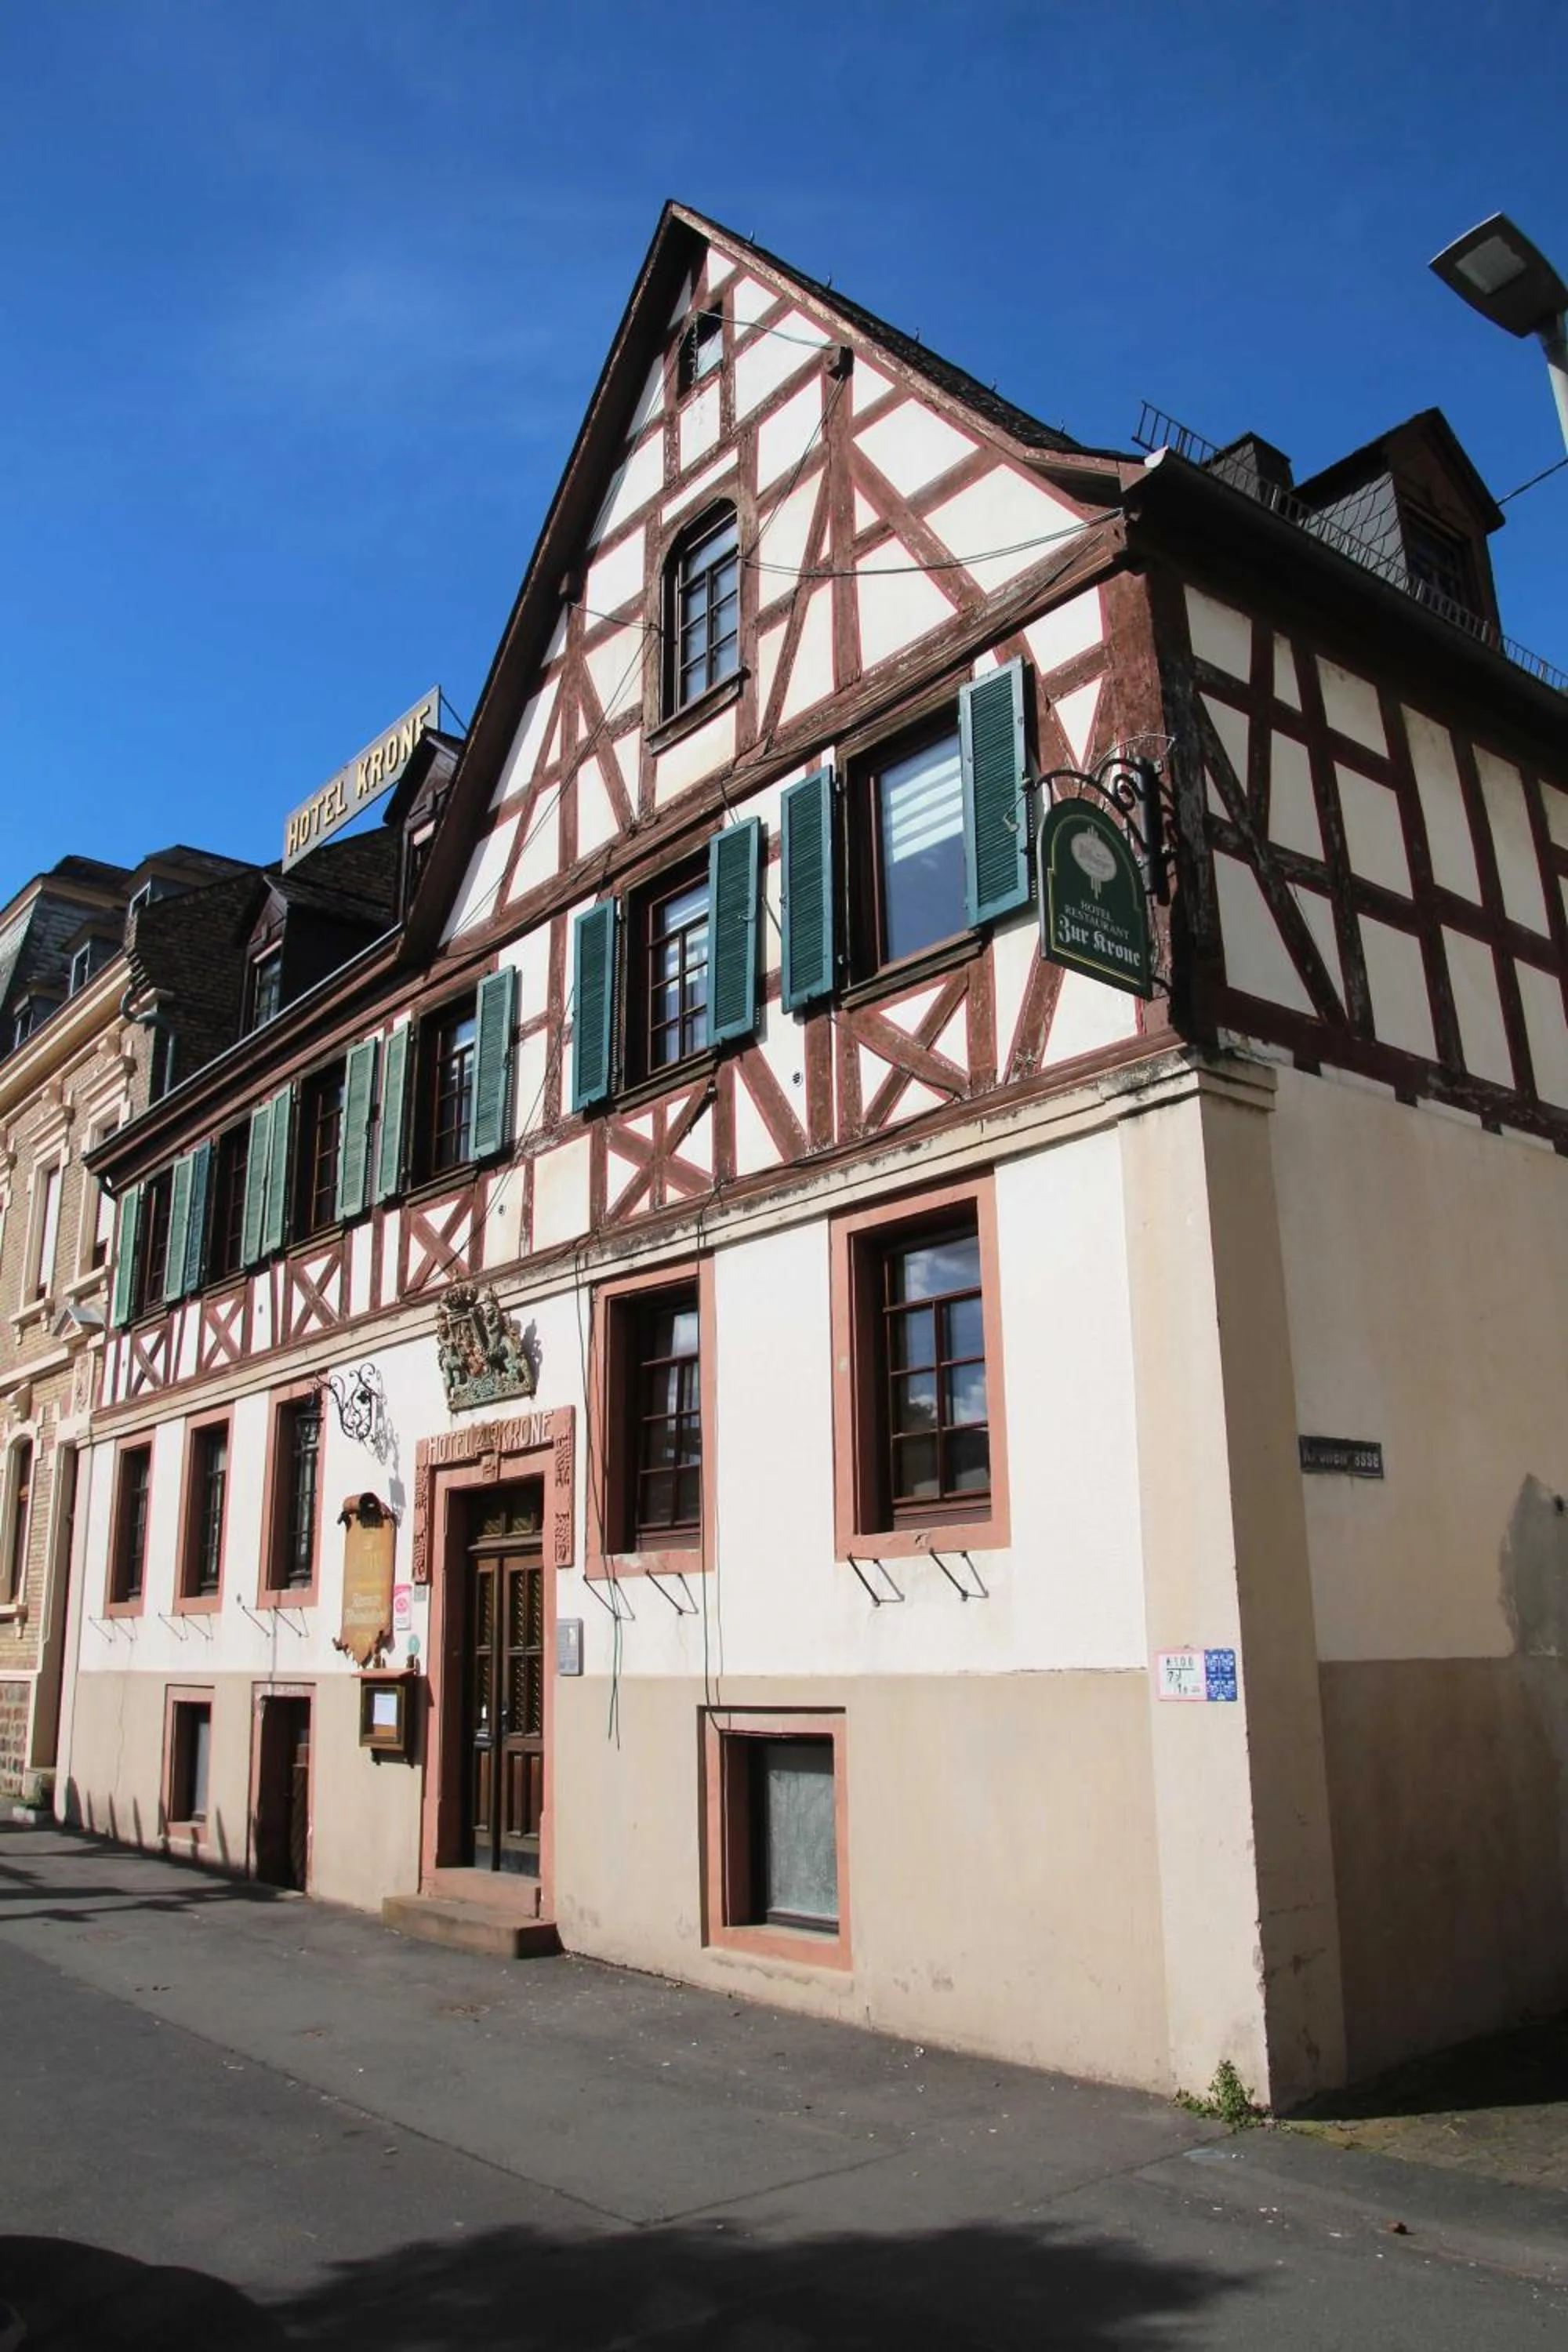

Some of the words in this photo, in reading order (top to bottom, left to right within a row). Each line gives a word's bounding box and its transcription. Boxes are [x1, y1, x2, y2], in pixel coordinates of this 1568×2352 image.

[288, 781, 347, 856] HOTEL
[1065, 904, 1130, 940] RESTAURANT
[1081, 901, 1112, 921] HOTEL
[1058, 915, 1089, 944] Zur
[1094, 931, 1141, 967] Krone
[428, 1426, 477, 1464] HOTEL
[499, 1412, 554, 1451] KRONE
